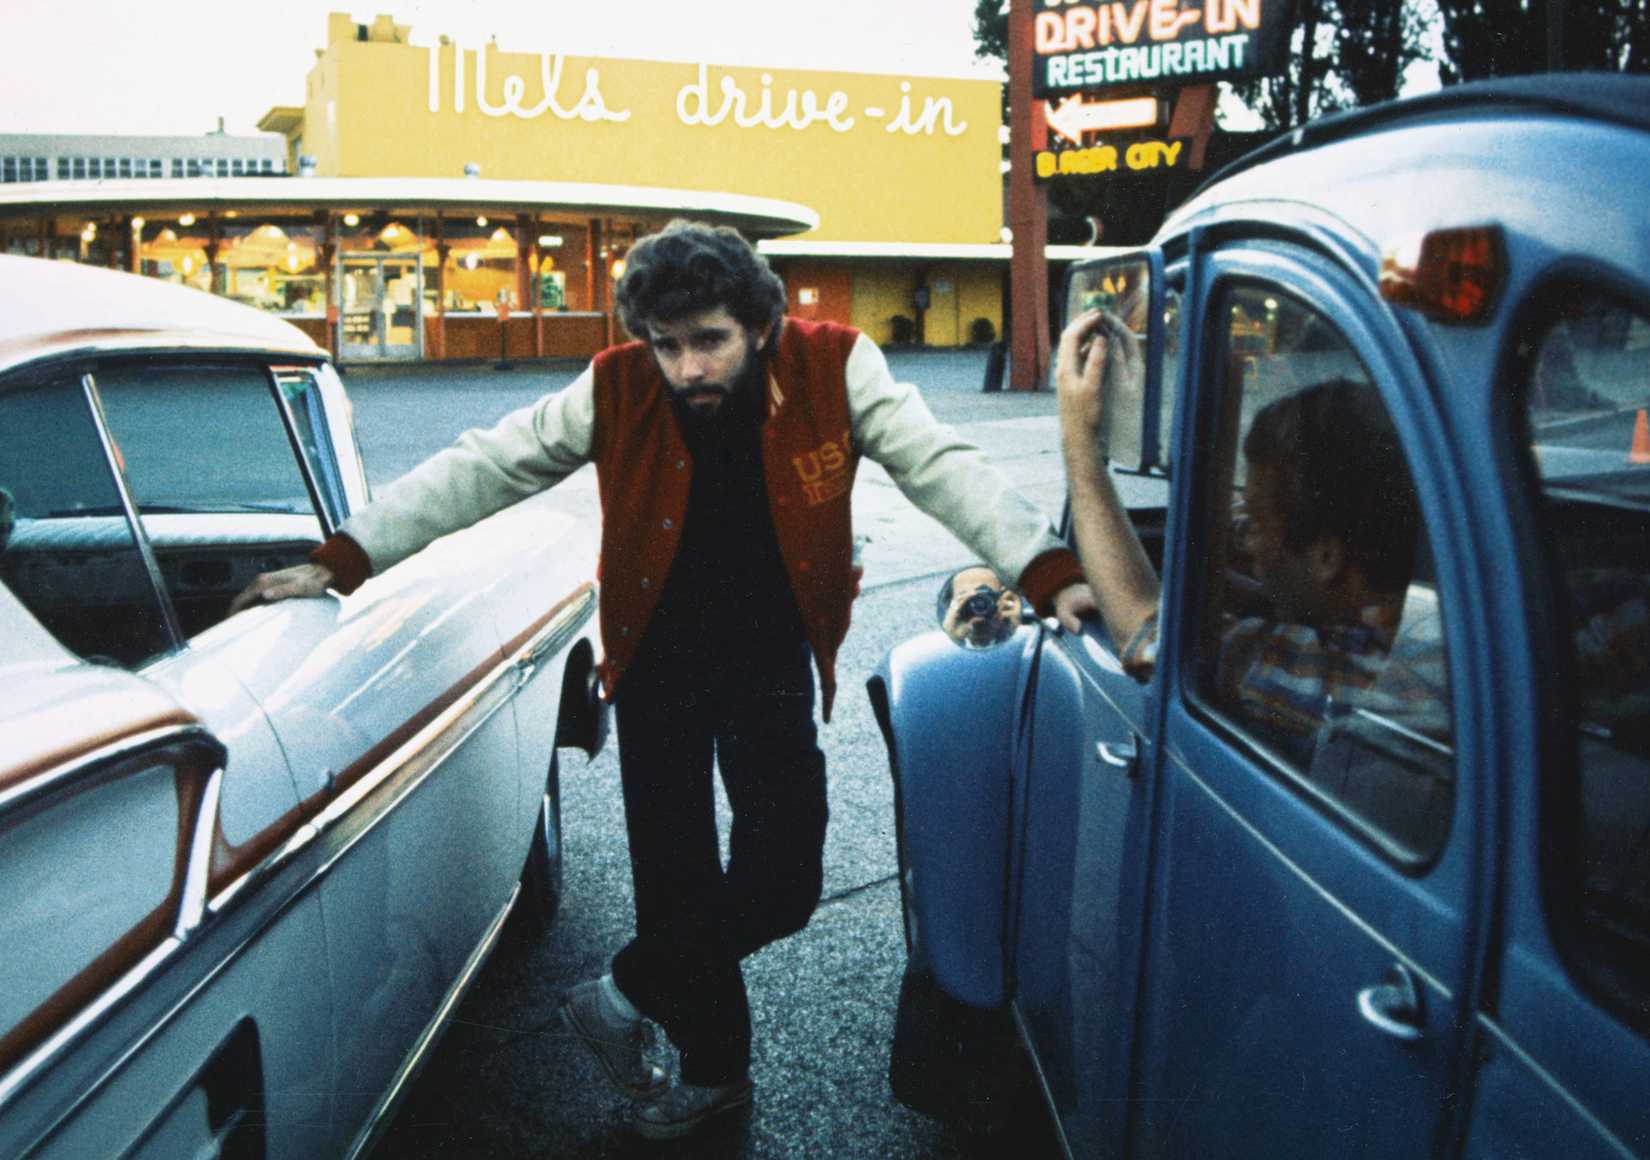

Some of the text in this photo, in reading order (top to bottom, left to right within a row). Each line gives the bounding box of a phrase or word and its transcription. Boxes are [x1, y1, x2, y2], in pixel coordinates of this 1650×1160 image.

[1035, 0, 1261, 54] DRIVE-IN
[429, 46, 631, 121] Mels
[1048, 35, 1249, 87] RESTAURANT
[1036, 140, 1182, 178] BRGER CITY
